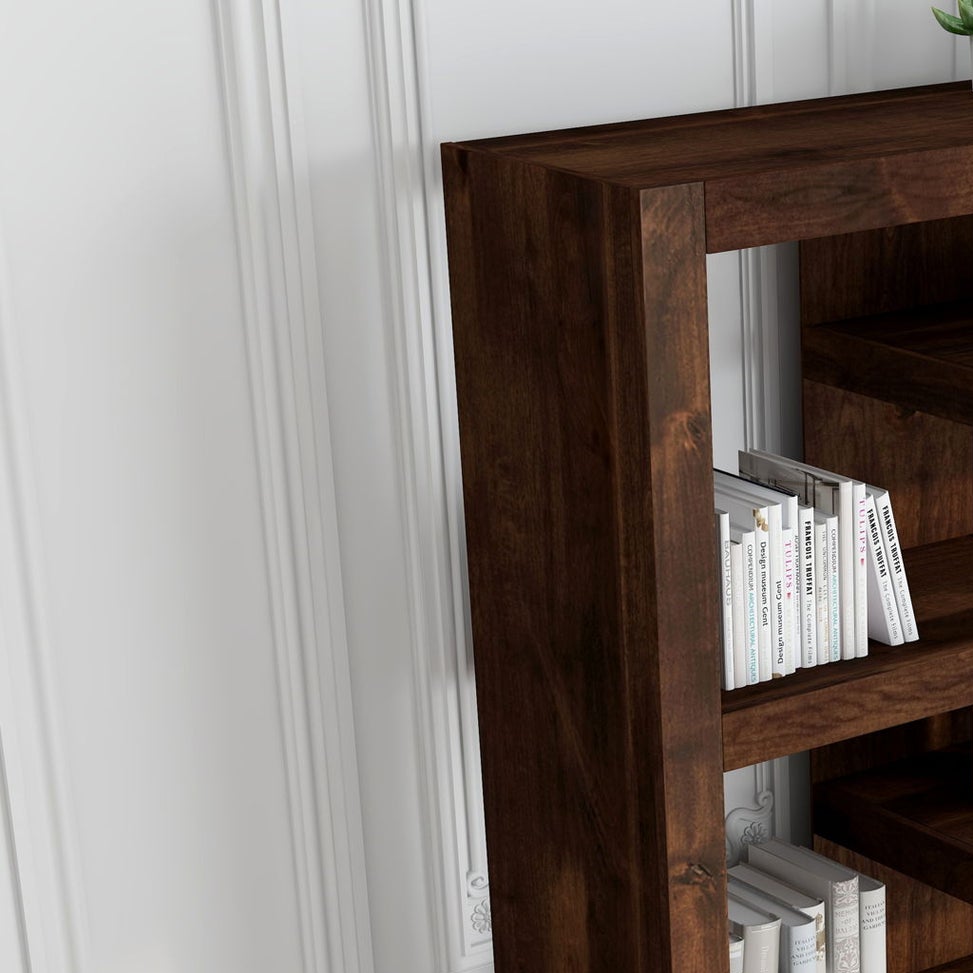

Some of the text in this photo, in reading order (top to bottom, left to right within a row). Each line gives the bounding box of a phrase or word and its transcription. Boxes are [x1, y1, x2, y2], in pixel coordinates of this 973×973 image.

[724, 540, 732, 607] BAUHAUS
[759, 542, 767, 570] Design
[784, 540, 792, 589] TULIPS
